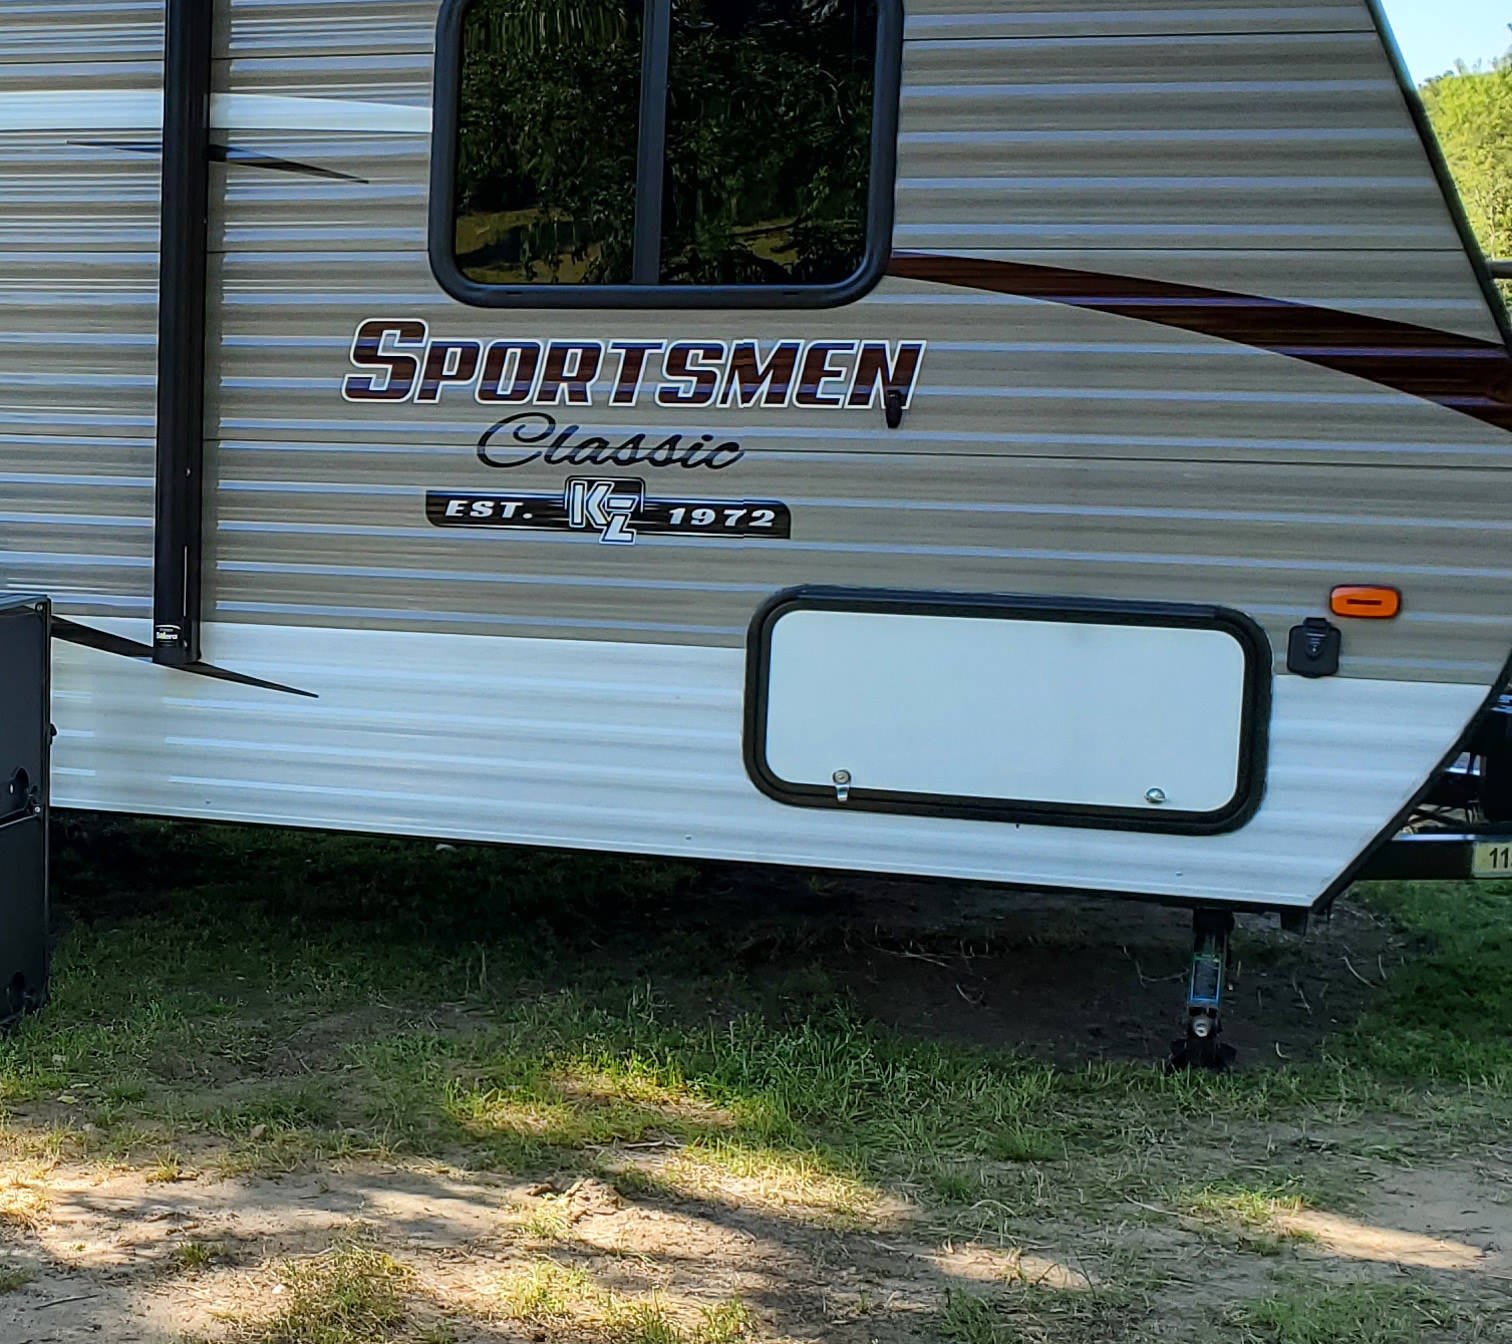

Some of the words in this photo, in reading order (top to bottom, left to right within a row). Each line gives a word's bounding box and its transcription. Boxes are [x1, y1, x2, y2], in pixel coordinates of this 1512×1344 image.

[341, 317, 927, 410] SPORTSMEN
[477, 411, 745, 470] Classic
[444, 499, 534, 520] EST.
[667, 507, 776, 529] 1972
